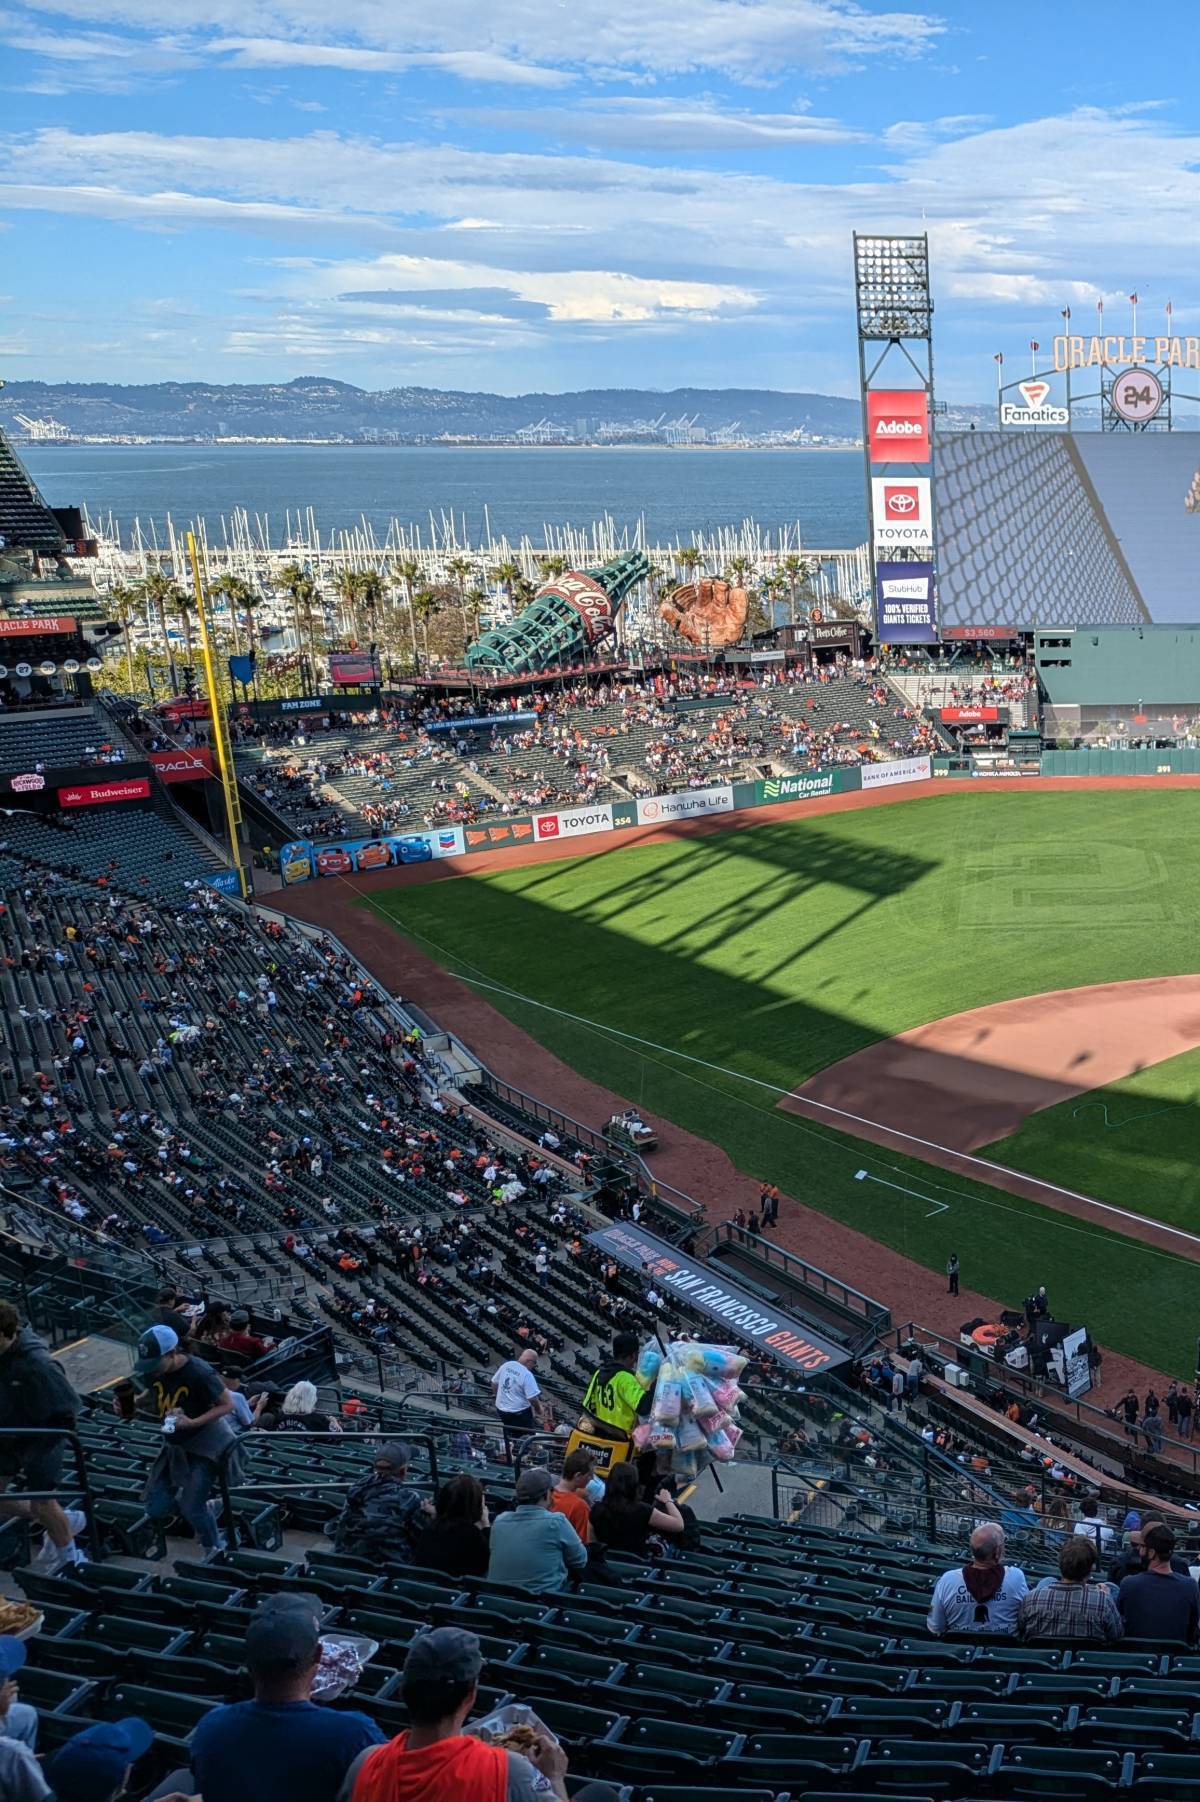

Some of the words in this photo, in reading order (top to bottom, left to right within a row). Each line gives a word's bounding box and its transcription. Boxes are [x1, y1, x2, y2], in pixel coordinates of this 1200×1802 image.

[1053, 335, 1146, 372] ORACLE
[1123, 385, 1156, 409] 24
[1004, 406, 1066, 422] Fanatics
[876, 420, 922, 434] Adobe
[878, 528, 928, 539] TOYOTA
[888, 584, 923, 593] StubHub
[884, 604, 901, 613] 100%
[901, 604, 928, 613] VERIFIED
[32, 619, 60, 631] PARK
[883, 614, 905, 624] GIANTS
[905, 614, 930, 624] TICKETS
[281, 701, 299, 710] FAM
[300, 700, 321, 709] ZONE
[958, 709, 981, 718] Adobe
[152, 758, 204, 773] RACLE
[863, 773, 880, 782] BANK
[889, 768, 917, 777] AMERICA
[933, 768, 949, 777] 399
[780, 774, 833, 794] National
[90, 786, 144, 799] Budweiser
[798, 791, 811, 799] Car
[811, 787, 831, 797] Rental
[661, 799, 706, 814] Hanwha
[707, 796, 729, 807] Life
[562, 813, 610, 829] TOYOTA
[614, 816, 632, 827] 354
[664, 1269, 700, 1291] SAN
[696, 1285, 778, 1336] FRANCISCO
[764, 1331, 831, 1369] GIANTS
[956, 1595, 975, 1604] BAIL
